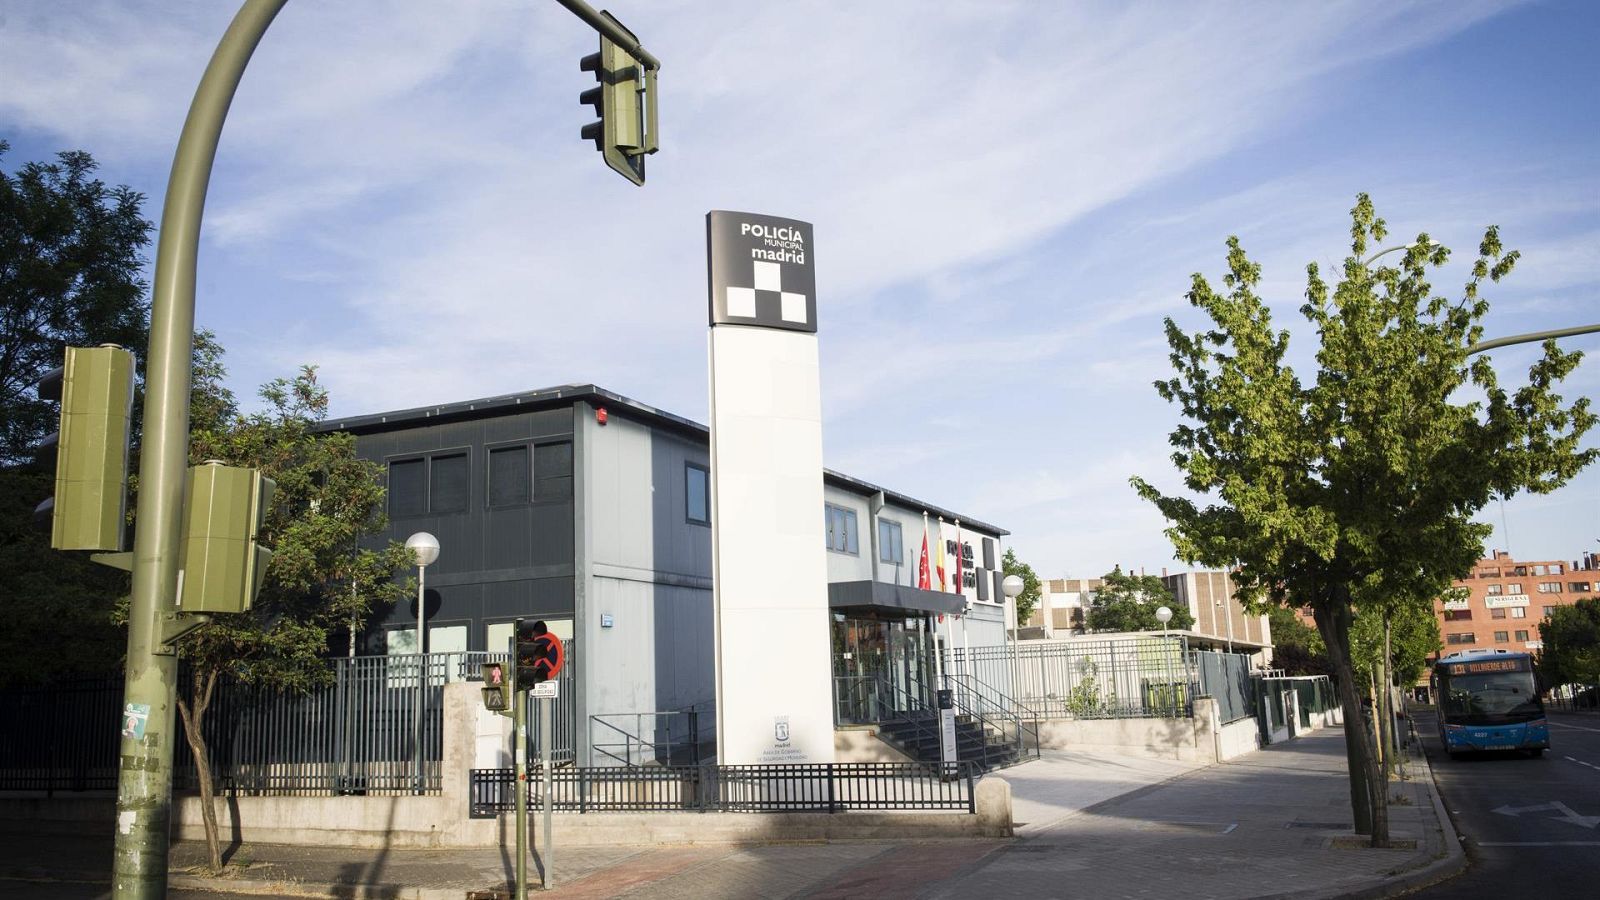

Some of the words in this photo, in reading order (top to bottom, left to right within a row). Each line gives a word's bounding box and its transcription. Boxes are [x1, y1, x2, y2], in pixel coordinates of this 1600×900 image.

[741, 223, 803, 243] POLICÍA
[764, 238, 803, 251] MUNICIPAL
[751, 248, 805, 264] madrid
